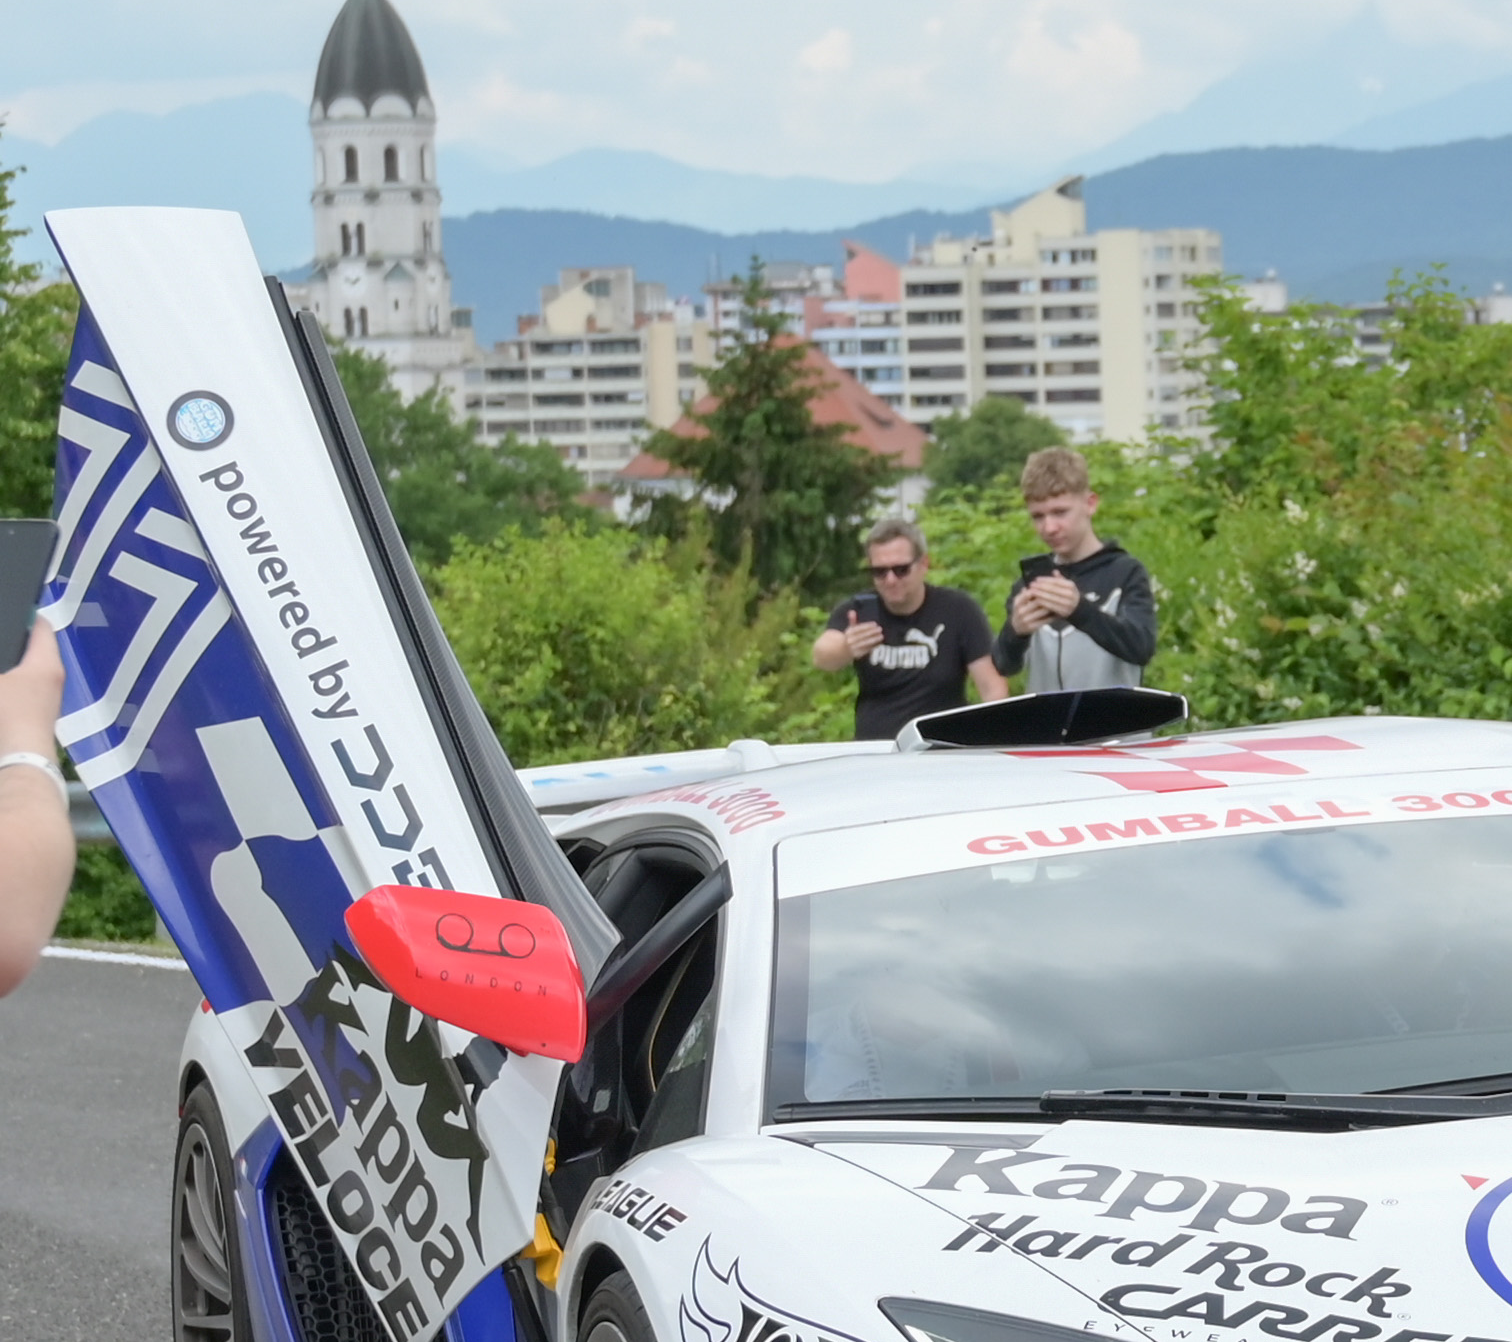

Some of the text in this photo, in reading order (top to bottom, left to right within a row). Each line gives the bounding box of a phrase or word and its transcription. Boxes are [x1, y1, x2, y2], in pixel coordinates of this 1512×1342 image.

[198, 460, 338, 659] powered
[307, 659, 360, 719] by
[966, 799, 1372, 856] GUMBALL
[415, 966, 547, 997] LONDON
[294, 959, 465, 1310] Kappa
[913, 1146, 1369, 1242] Kappa
[941, 1212, 1412, 1319] Hard Rock
